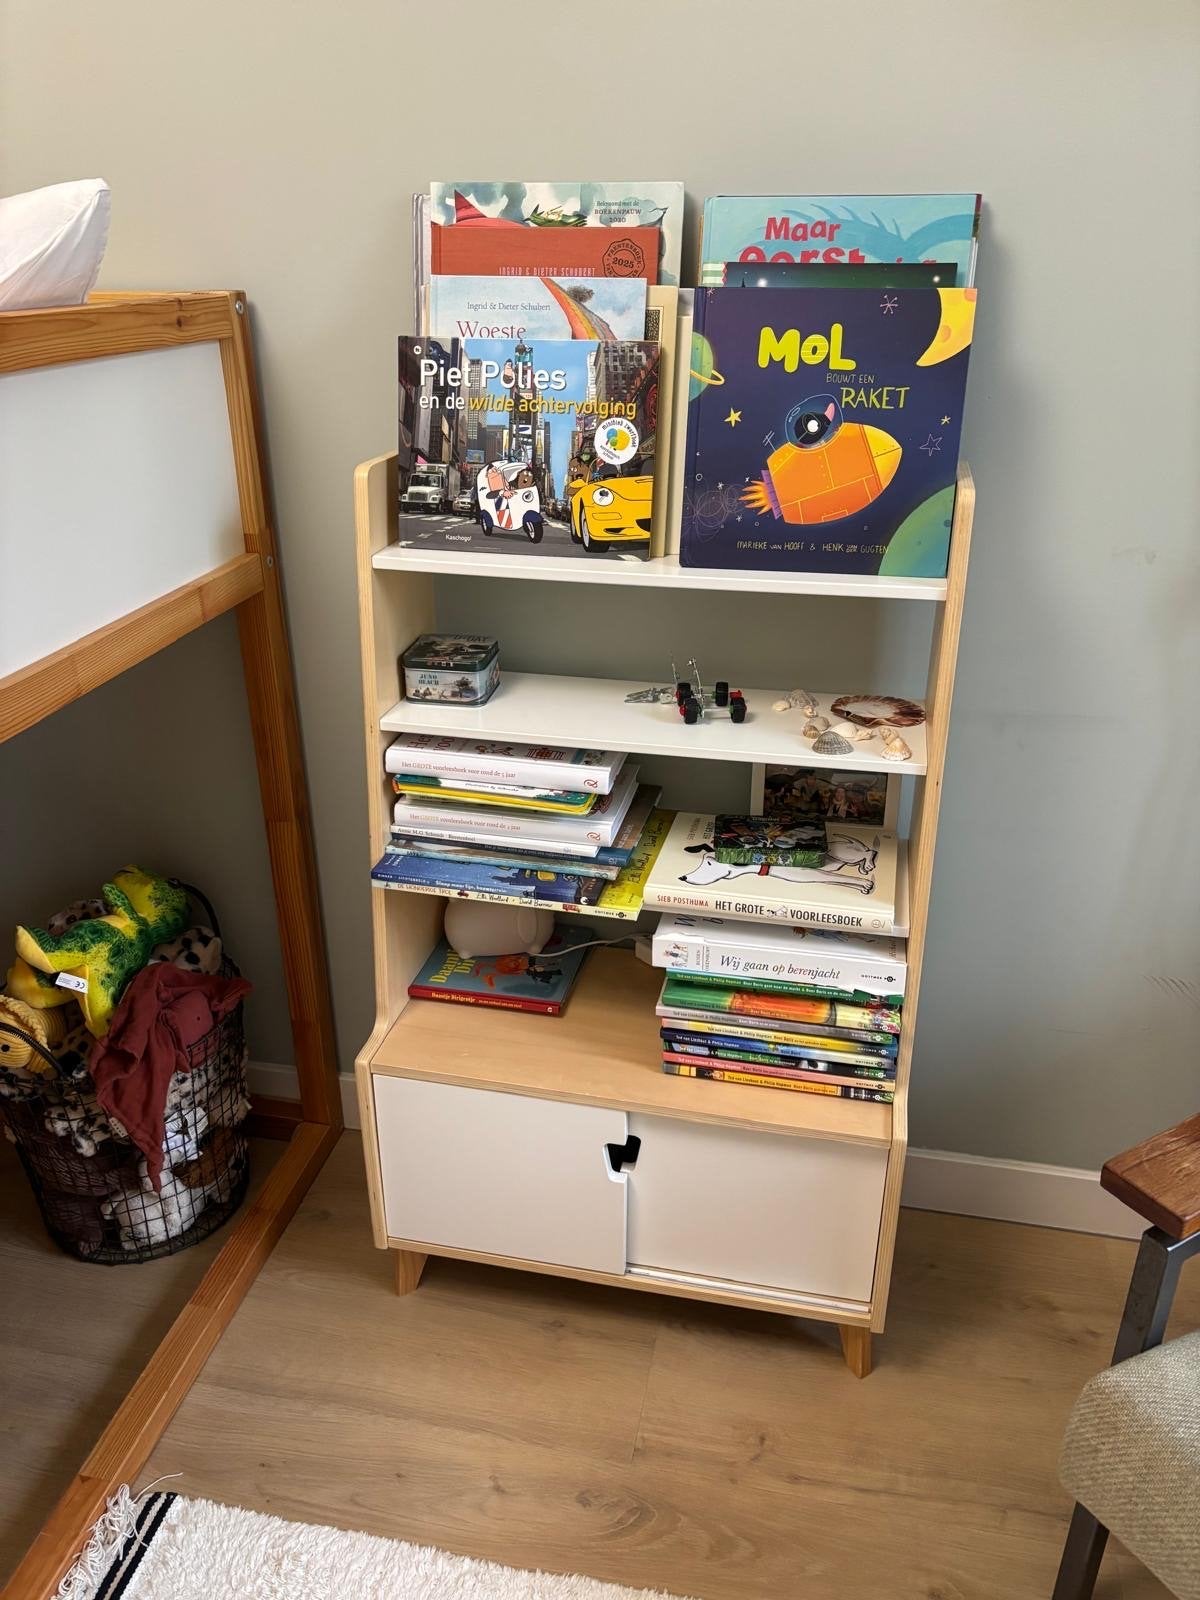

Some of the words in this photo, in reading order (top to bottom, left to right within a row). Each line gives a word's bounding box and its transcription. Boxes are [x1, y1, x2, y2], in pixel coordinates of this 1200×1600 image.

[764, 216, 841, 242] Maar
[612, 256, 635, 269] 2025
[467, 301, 488, 312] Ingrid
[489, 302, 496, 310] &
[498, 302, 518, 311] Dieter
[519, 302, 551, 312] Schubert
[456, 320, 527, 339] Woeste
[419, 358, 472, 389] Piet
[480, 360, 568, 391] Polies
[826, 372, 856, 384] BOUWT
[859, 374, 875, 384] EEN
[420, 396, 440, 410] en
[445, 392, 466, 410] de
[469, 395, 515, 413] wilde
[518, 397, 637, 420] achtervolging
[840, 386, 910, 409] RAKET
[736, 540, 767, 550] MARIEKE
[810, 543, 816, 551] &
[822, 543, 844, 552] HENK
[656, 894, 671, 903] SIEB
[673, 896, 710, 908] POSTHUMA
[715, 900, 732, 912] HET
[734, 902, 765, 916] GROTE
[790, 909, 862, 928] VOORLEESBOEK
[720, 954, 741, 971] Wij
[742, 962, 769, 972] gaan
[772, 964, 786, 975] op
[788, 963, 842, 980] berenjacht
